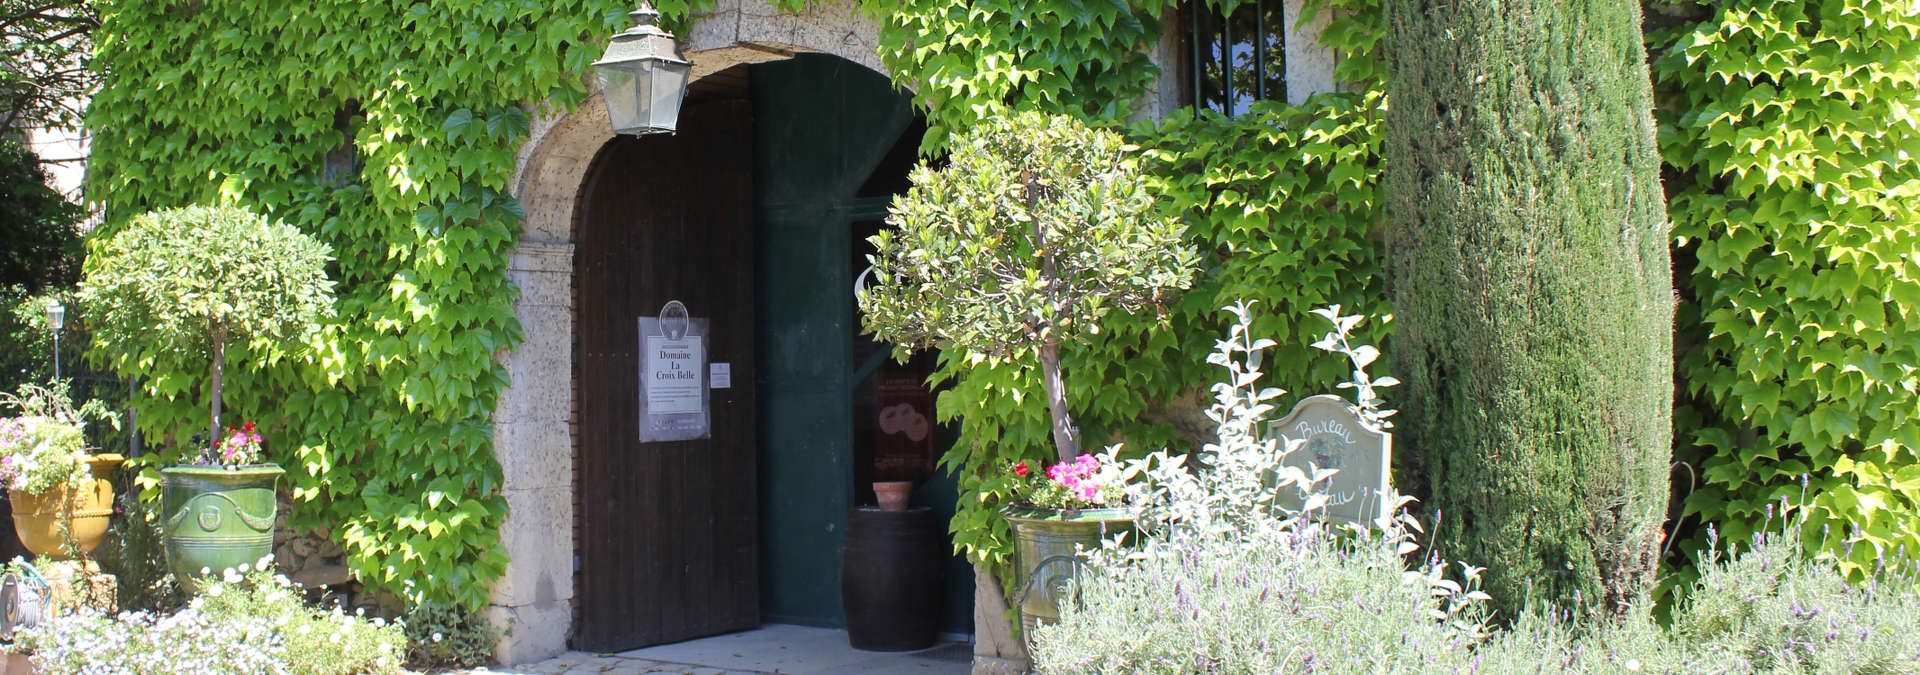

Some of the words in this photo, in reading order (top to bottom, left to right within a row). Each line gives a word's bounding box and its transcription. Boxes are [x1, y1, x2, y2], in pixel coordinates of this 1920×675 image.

[660, 351, 691, 359] Domaine
[671, 361, 680, 370] La
[656, 371, 676, 380] Croix
[677, 370, 694, 380] Belle
[1296, 419, 1356, 445] Bureau
